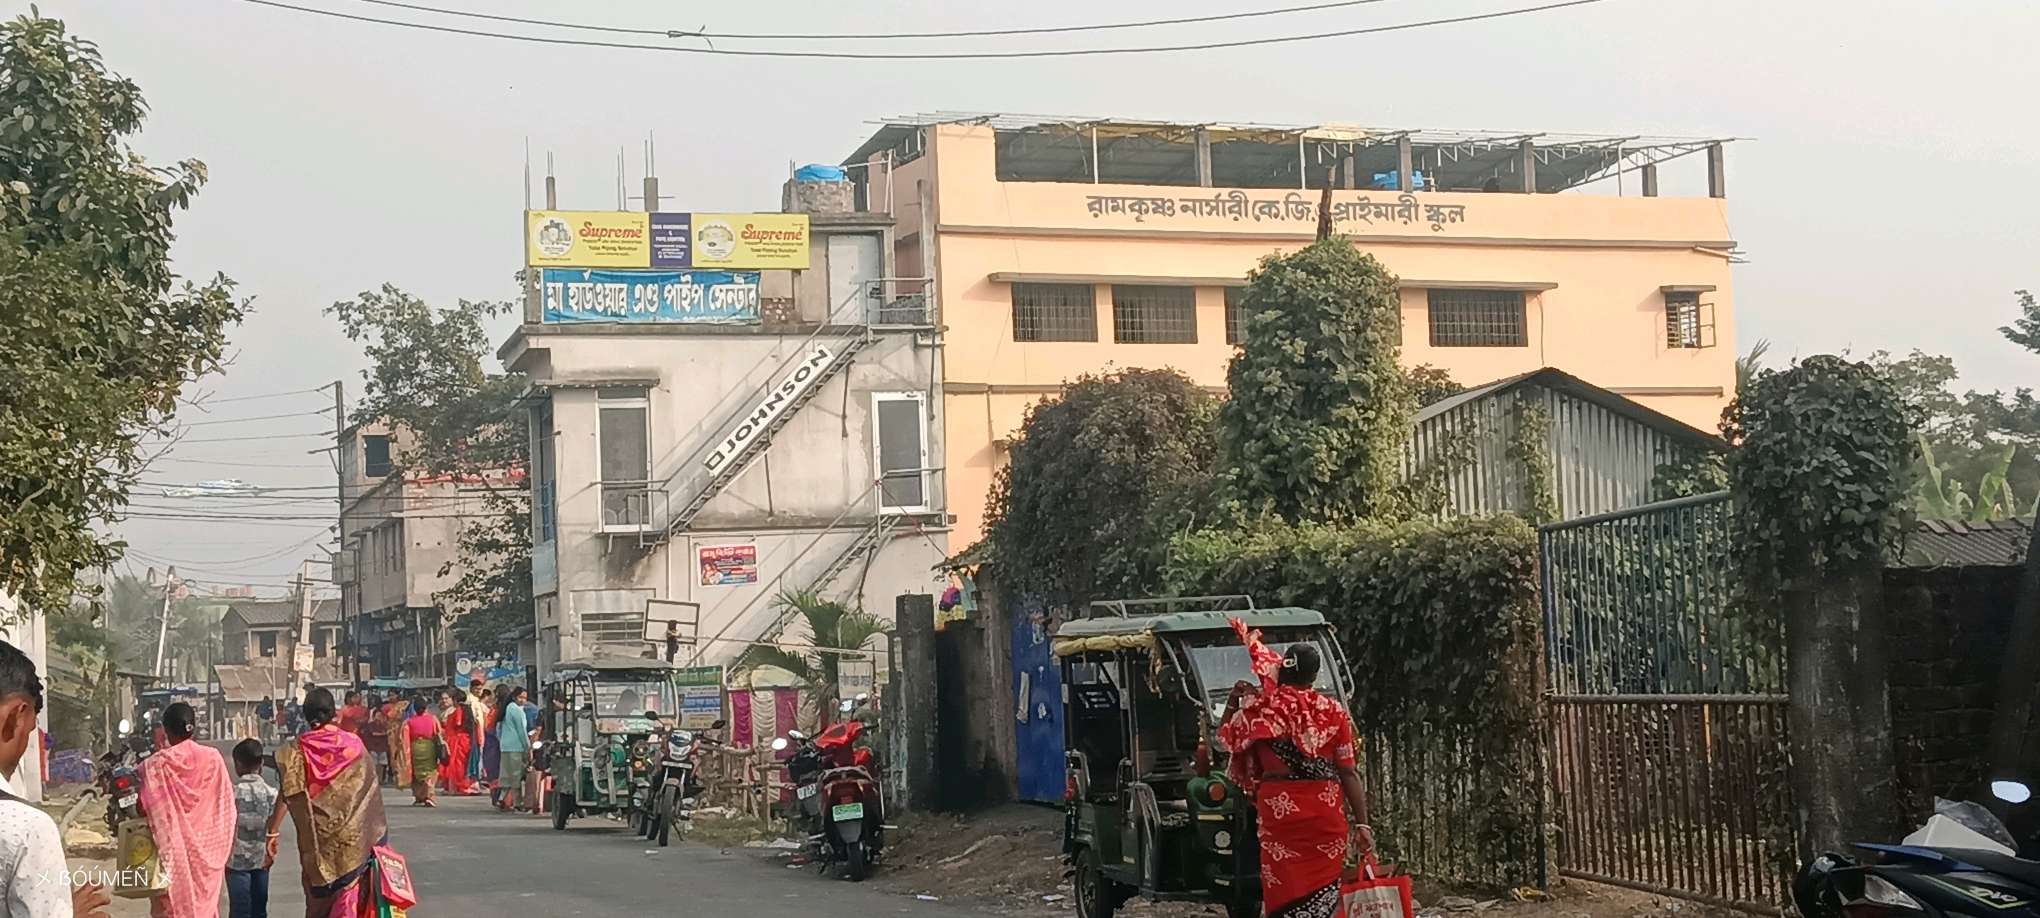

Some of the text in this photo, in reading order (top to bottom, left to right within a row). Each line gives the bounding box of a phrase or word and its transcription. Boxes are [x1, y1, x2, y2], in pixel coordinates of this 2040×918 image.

[579, 221, 642, 241] Supreme
[1086, 195, 1175, 222] রামকৃষ্ণ
[1179, 190, 1248, 222] নার্সারী
[1333, 194, 1419, 225] প্রাইমারী
[1424, 204, 1465, 232] স্কুল
[741, 223, 802, 243] Supreme
[546, 282, 563, 313] মা
[664, 274, 705, 313] পাইপ
[709, 274, 757, 316] সেন্টার
[727, 349, 828, 454] JOHNSON
